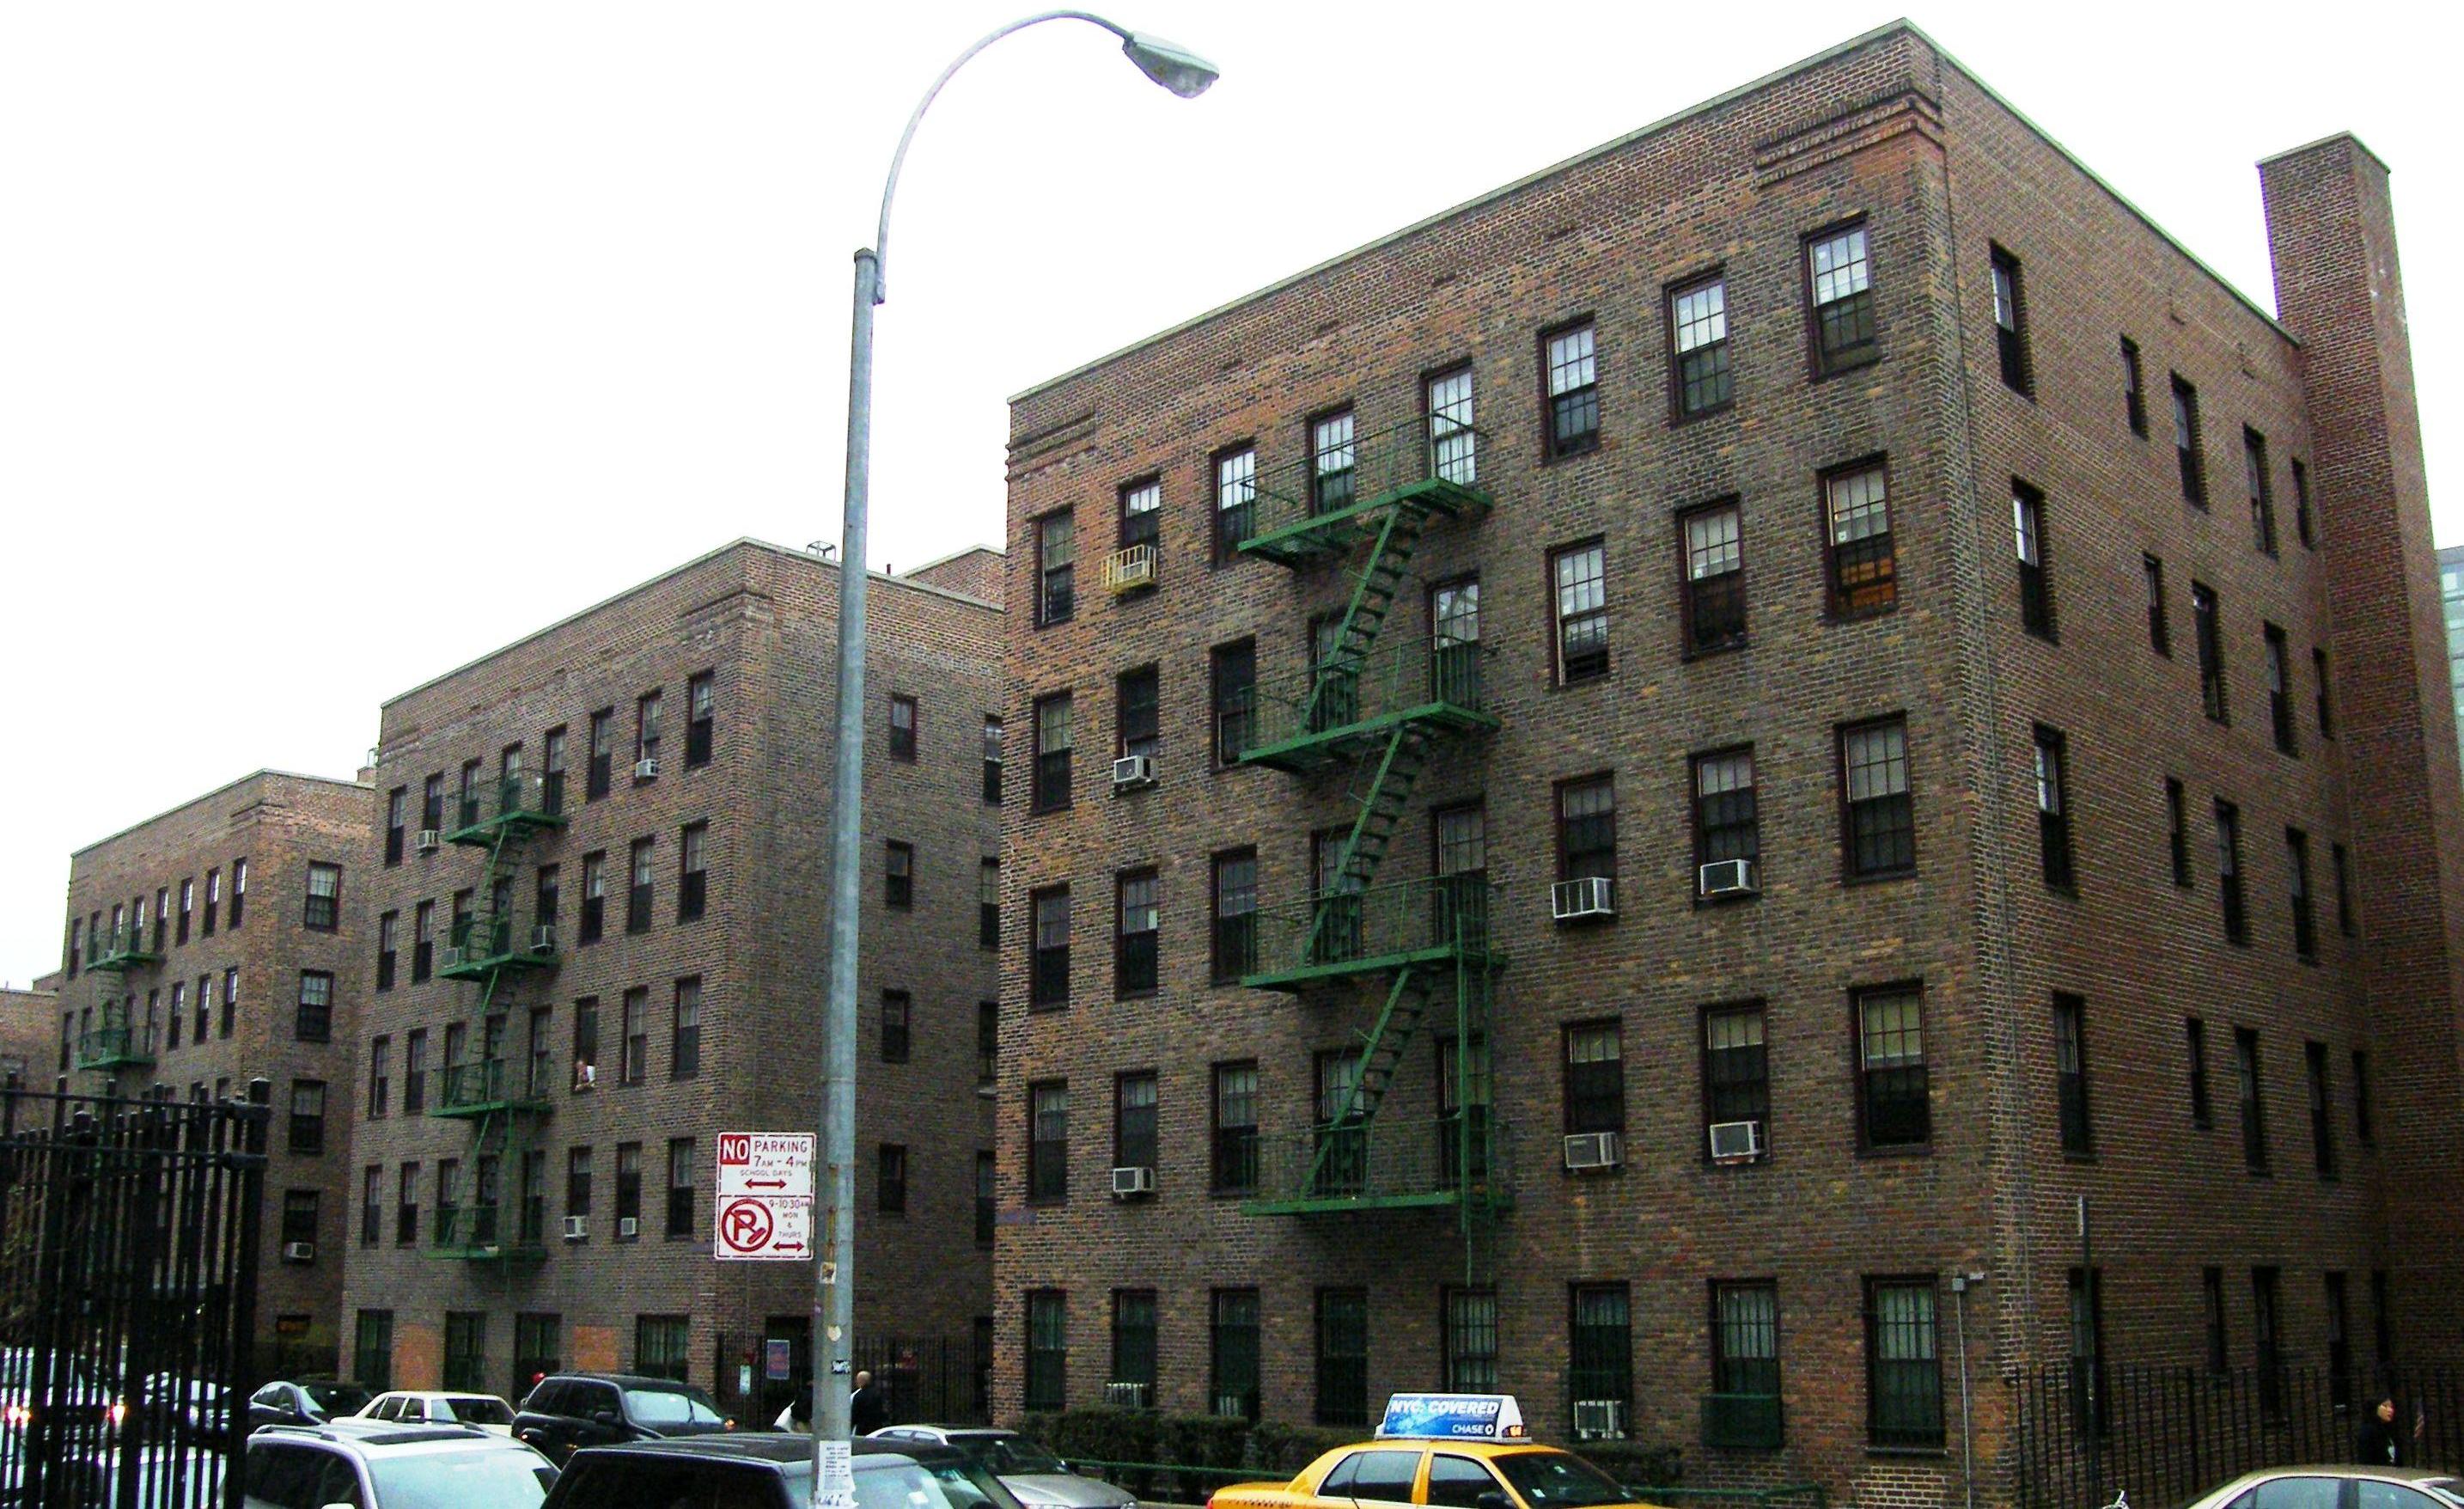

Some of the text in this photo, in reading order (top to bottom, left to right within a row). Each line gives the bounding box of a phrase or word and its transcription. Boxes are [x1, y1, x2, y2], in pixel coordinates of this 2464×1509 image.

[722, 1139, 808, 1161] NO PARKING
[1428, 1401, 1500, 1416] COVERED
[1452, 1424, 1485, 1434] CHASE
